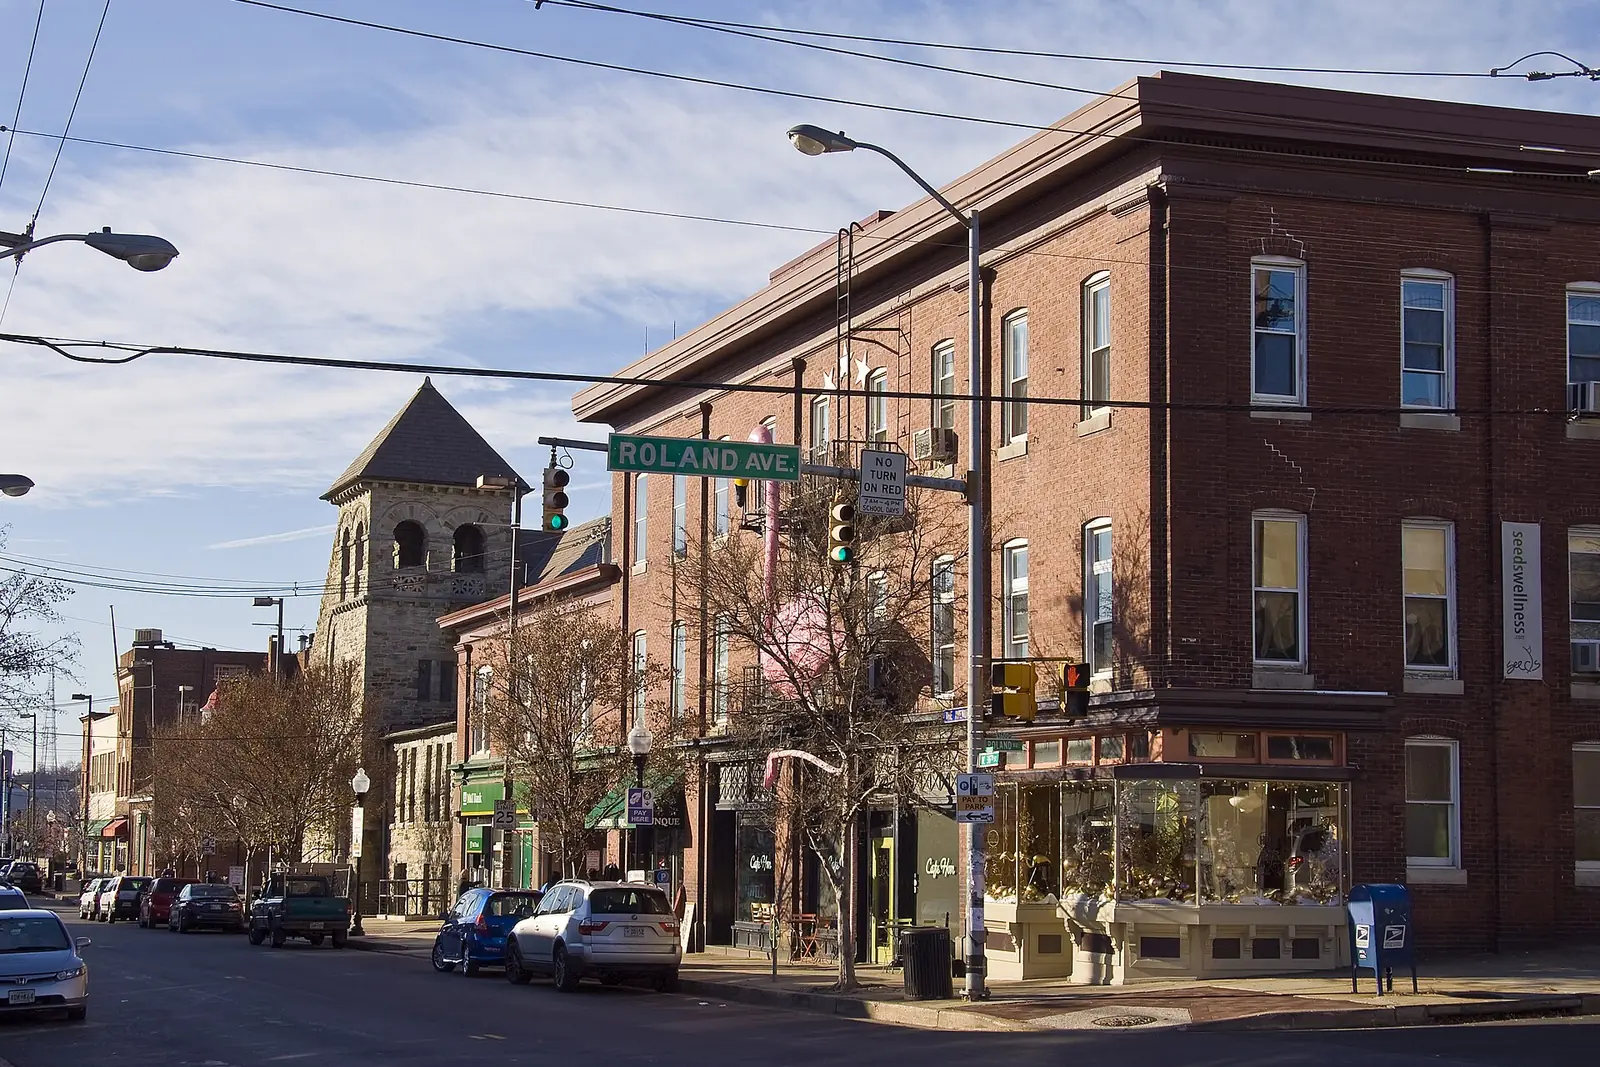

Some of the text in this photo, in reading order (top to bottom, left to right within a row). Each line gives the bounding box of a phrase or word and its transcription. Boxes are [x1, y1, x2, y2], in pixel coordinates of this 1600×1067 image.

[619, 441, 795, 473] ROLAND AVE.
[875, 457, 893, 467] NO
[870, 470, 897, 481] TURN
[863, 482, 902, 495] ON RED
[862, 504, 900, 514] SCHOOL DAYS
[1512, 531, 1527, 634] seedswellness
[987, 740, 1012, 750] ROLAND
[496, 811, 514, 824] 25
[940, 857, 956, 878] Hon
